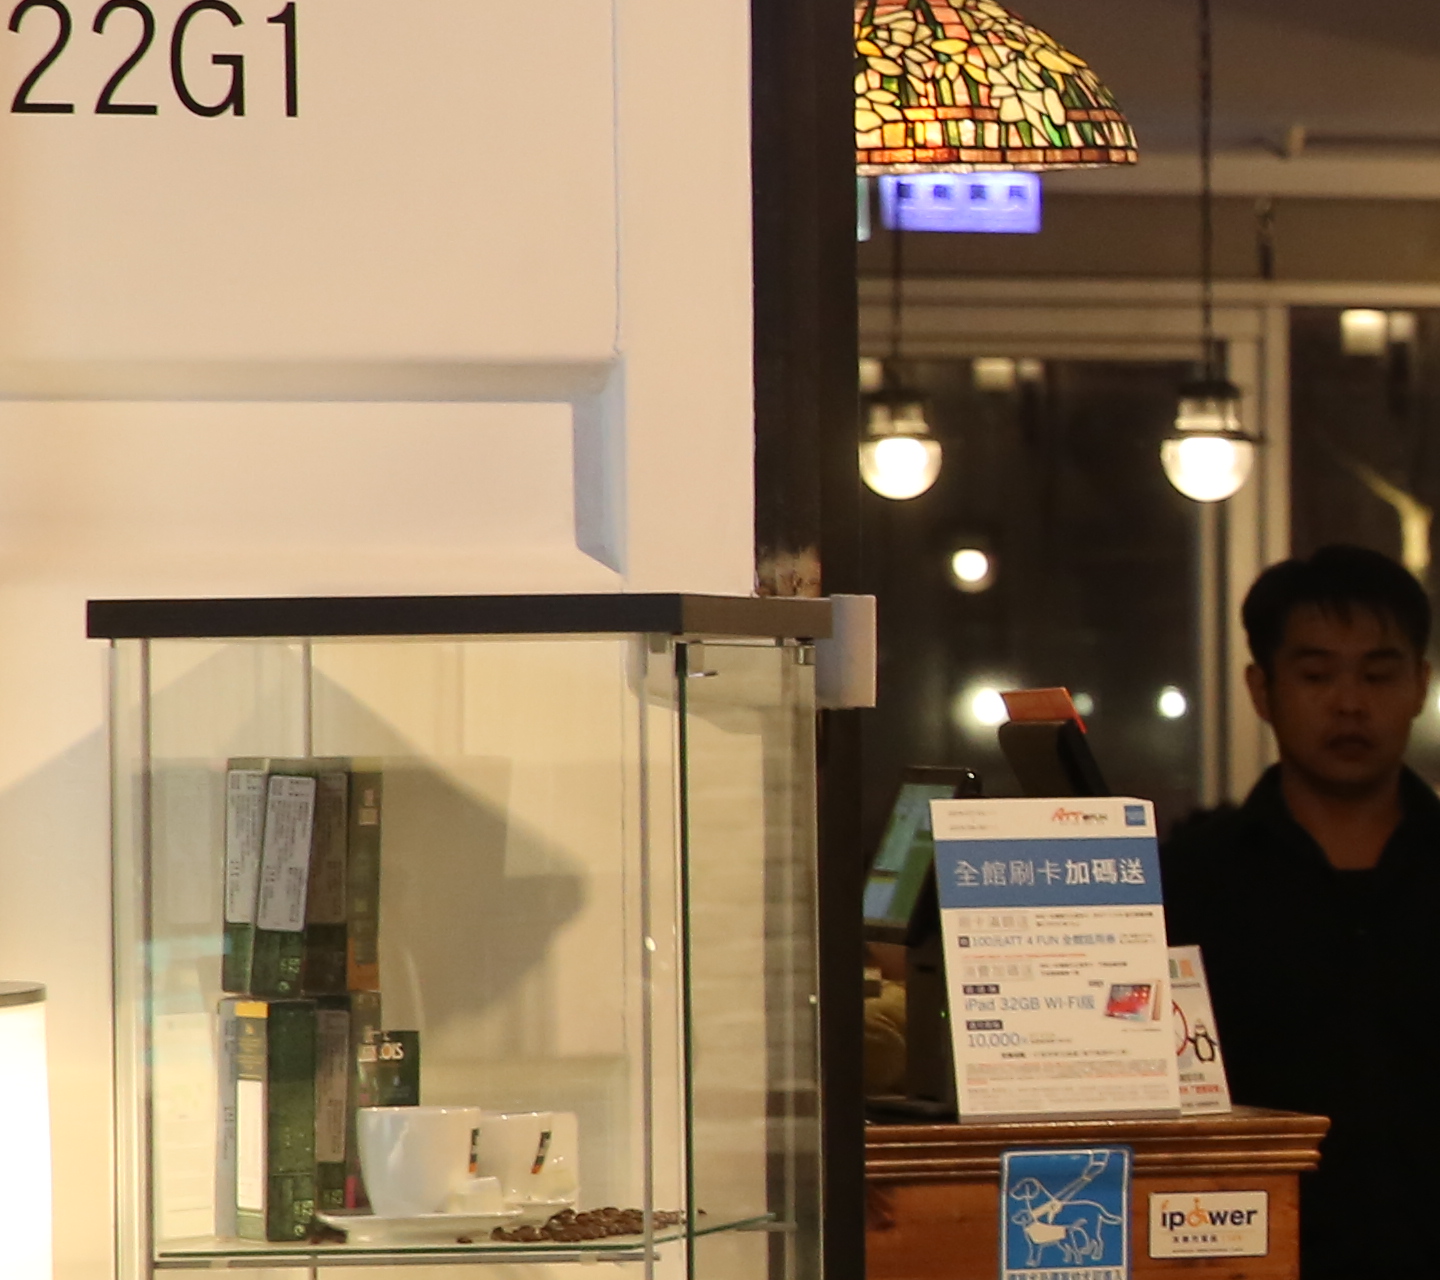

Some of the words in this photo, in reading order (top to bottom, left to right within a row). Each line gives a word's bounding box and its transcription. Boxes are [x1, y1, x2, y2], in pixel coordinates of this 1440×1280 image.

[954, 857, 1146, 887] 全館刷卡加碼送
[1000, 995, 1041, 1011] 32GB
